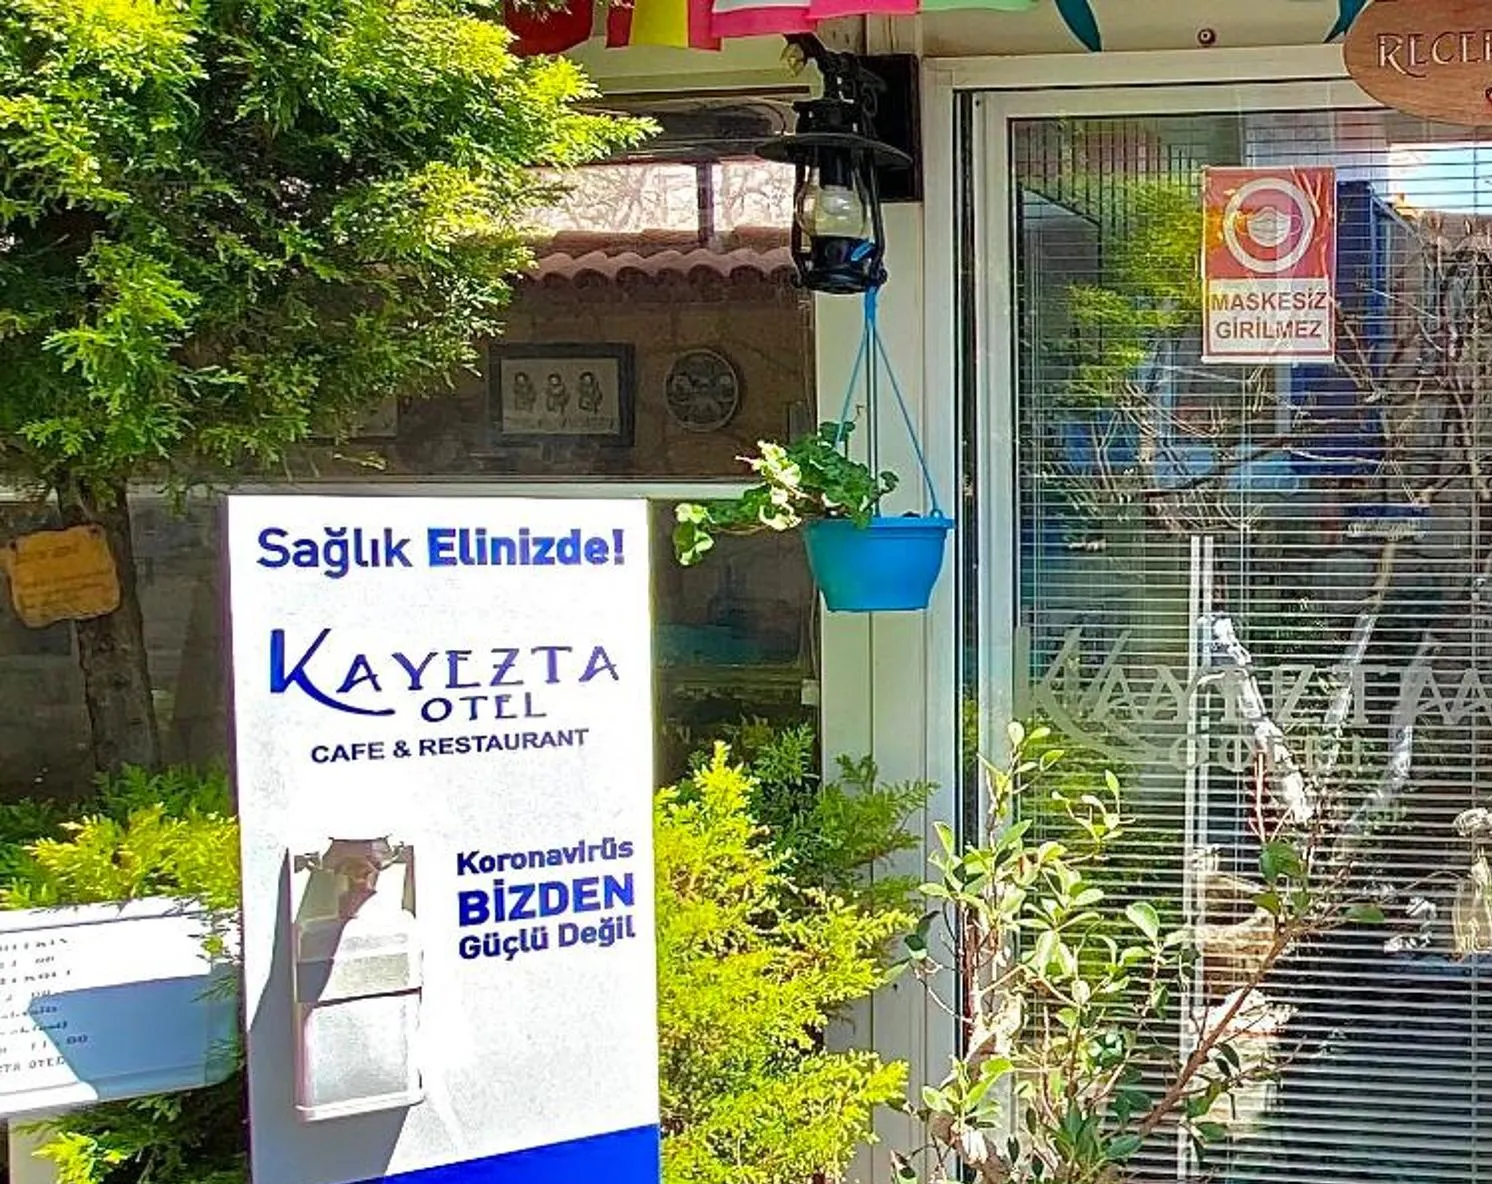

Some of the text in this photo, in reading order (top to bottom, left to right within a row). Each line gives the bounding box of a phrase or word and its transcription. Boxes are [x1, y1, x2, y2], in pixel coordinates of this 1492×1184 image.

[1212, 287, 1327, 311] MASKESİZ
[1215, 316, 1322, 339] GİRİLMEZ
[257, 527, 624, 579] Sağlık Elinizde!
[270, 628, 619, 716] KAYEZTA
[420, 692, 547, 723] OTEL
[311, 728, 589, 763] CAFE & RESTAURANT
[456, 837, 634, 875] Koronavirüs
[458, 873, 635, 927] BİZDEN
[459, 915, 636, 961] Güçlü Değil
